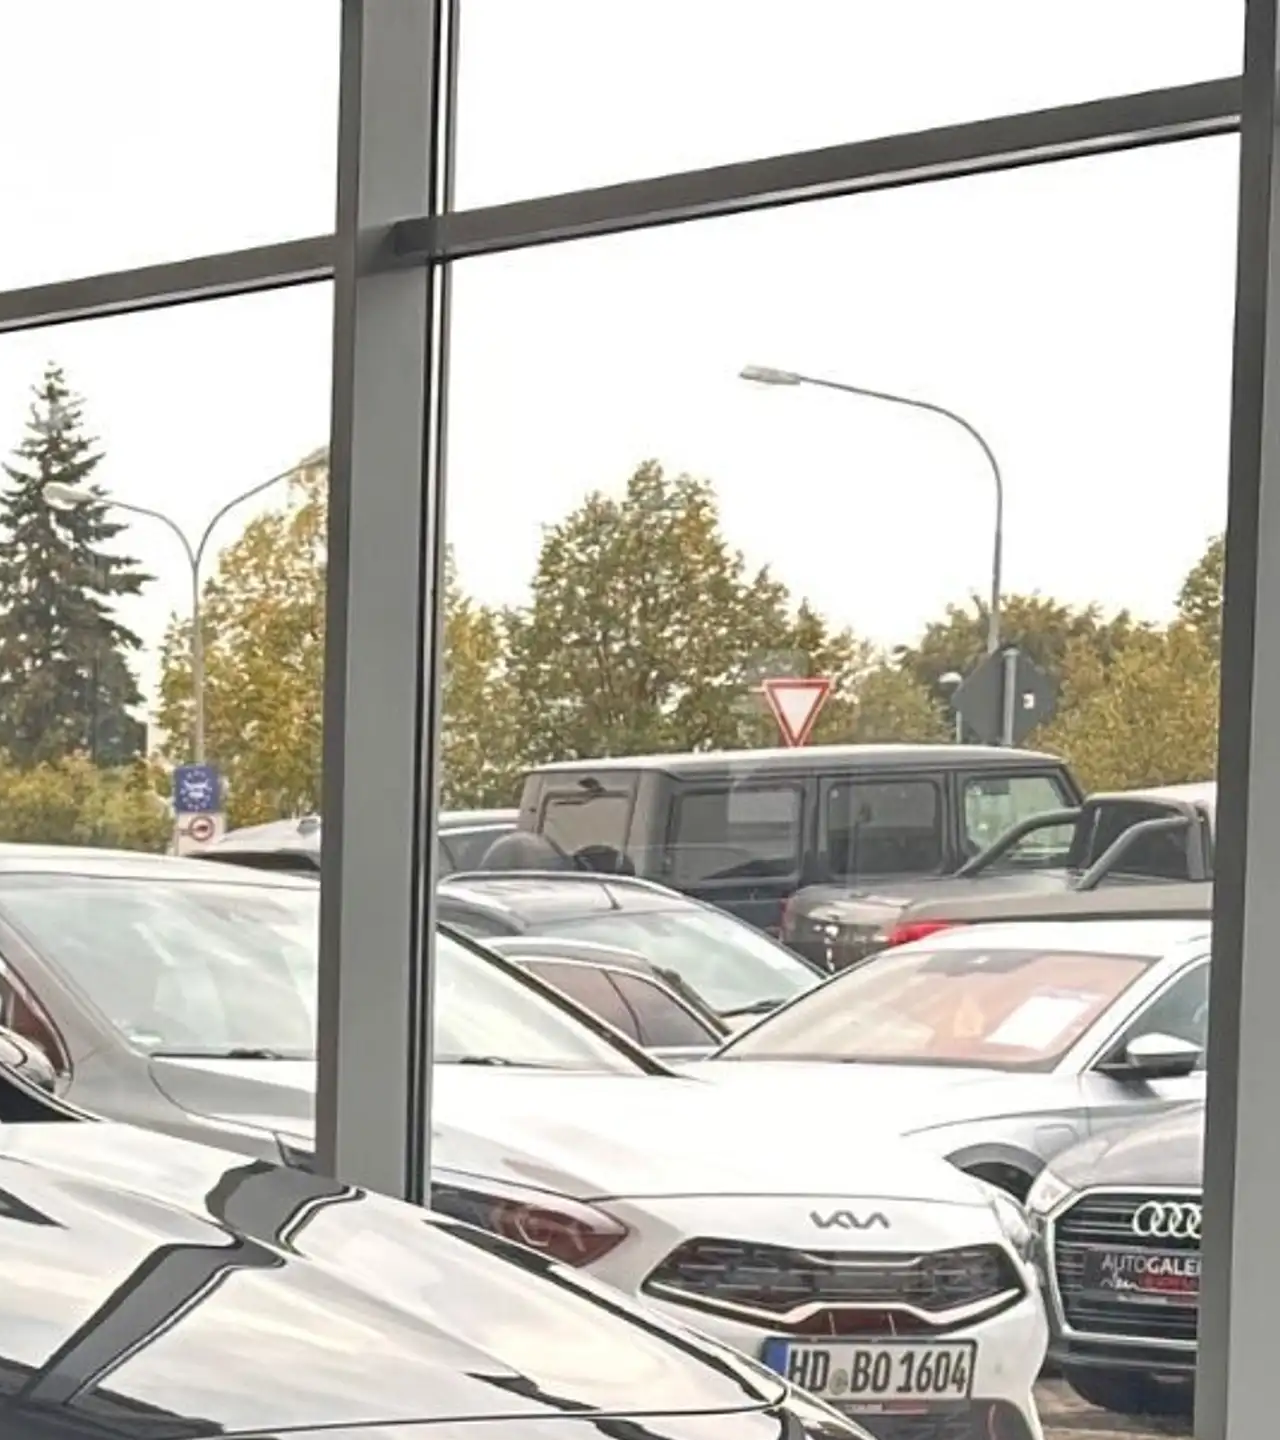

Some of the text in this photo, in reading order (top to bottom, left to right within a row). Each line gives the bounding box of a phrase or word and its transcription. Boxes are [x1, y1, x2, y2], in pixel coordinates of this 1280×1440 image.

[1101, 1253, 1200, 1276] AUTOGALE
[789, 1351, 831, 1393] HD
[896, 1351, 967, 1394] 1604
